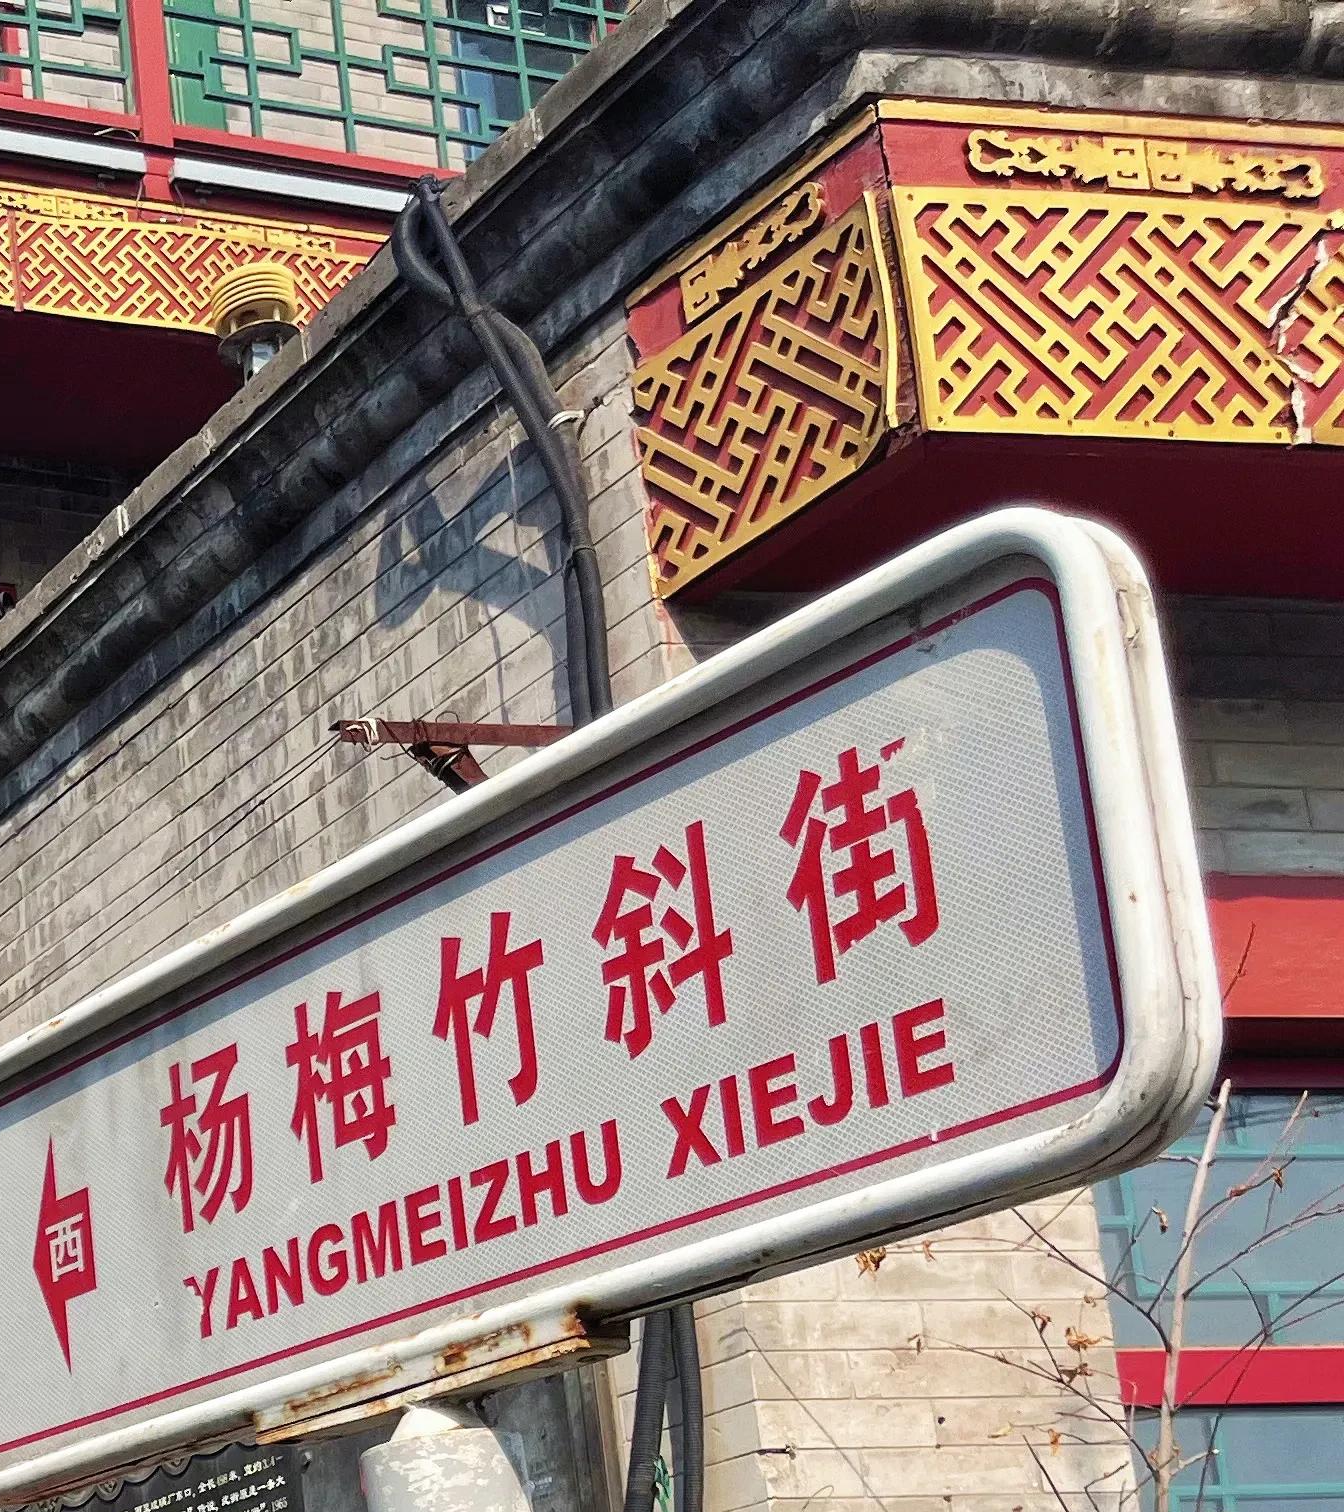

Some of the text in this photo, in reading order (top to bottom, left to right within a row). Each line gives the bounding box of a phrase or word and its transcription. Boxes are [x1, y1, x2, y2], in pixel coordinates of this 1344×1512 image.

[162, 738, 940, 1233] 杨梅竹斜街
[47, 1212, 86, 1274] 西
[185, 999, 958, 1338] YANGMEIZHU XIEJIE
